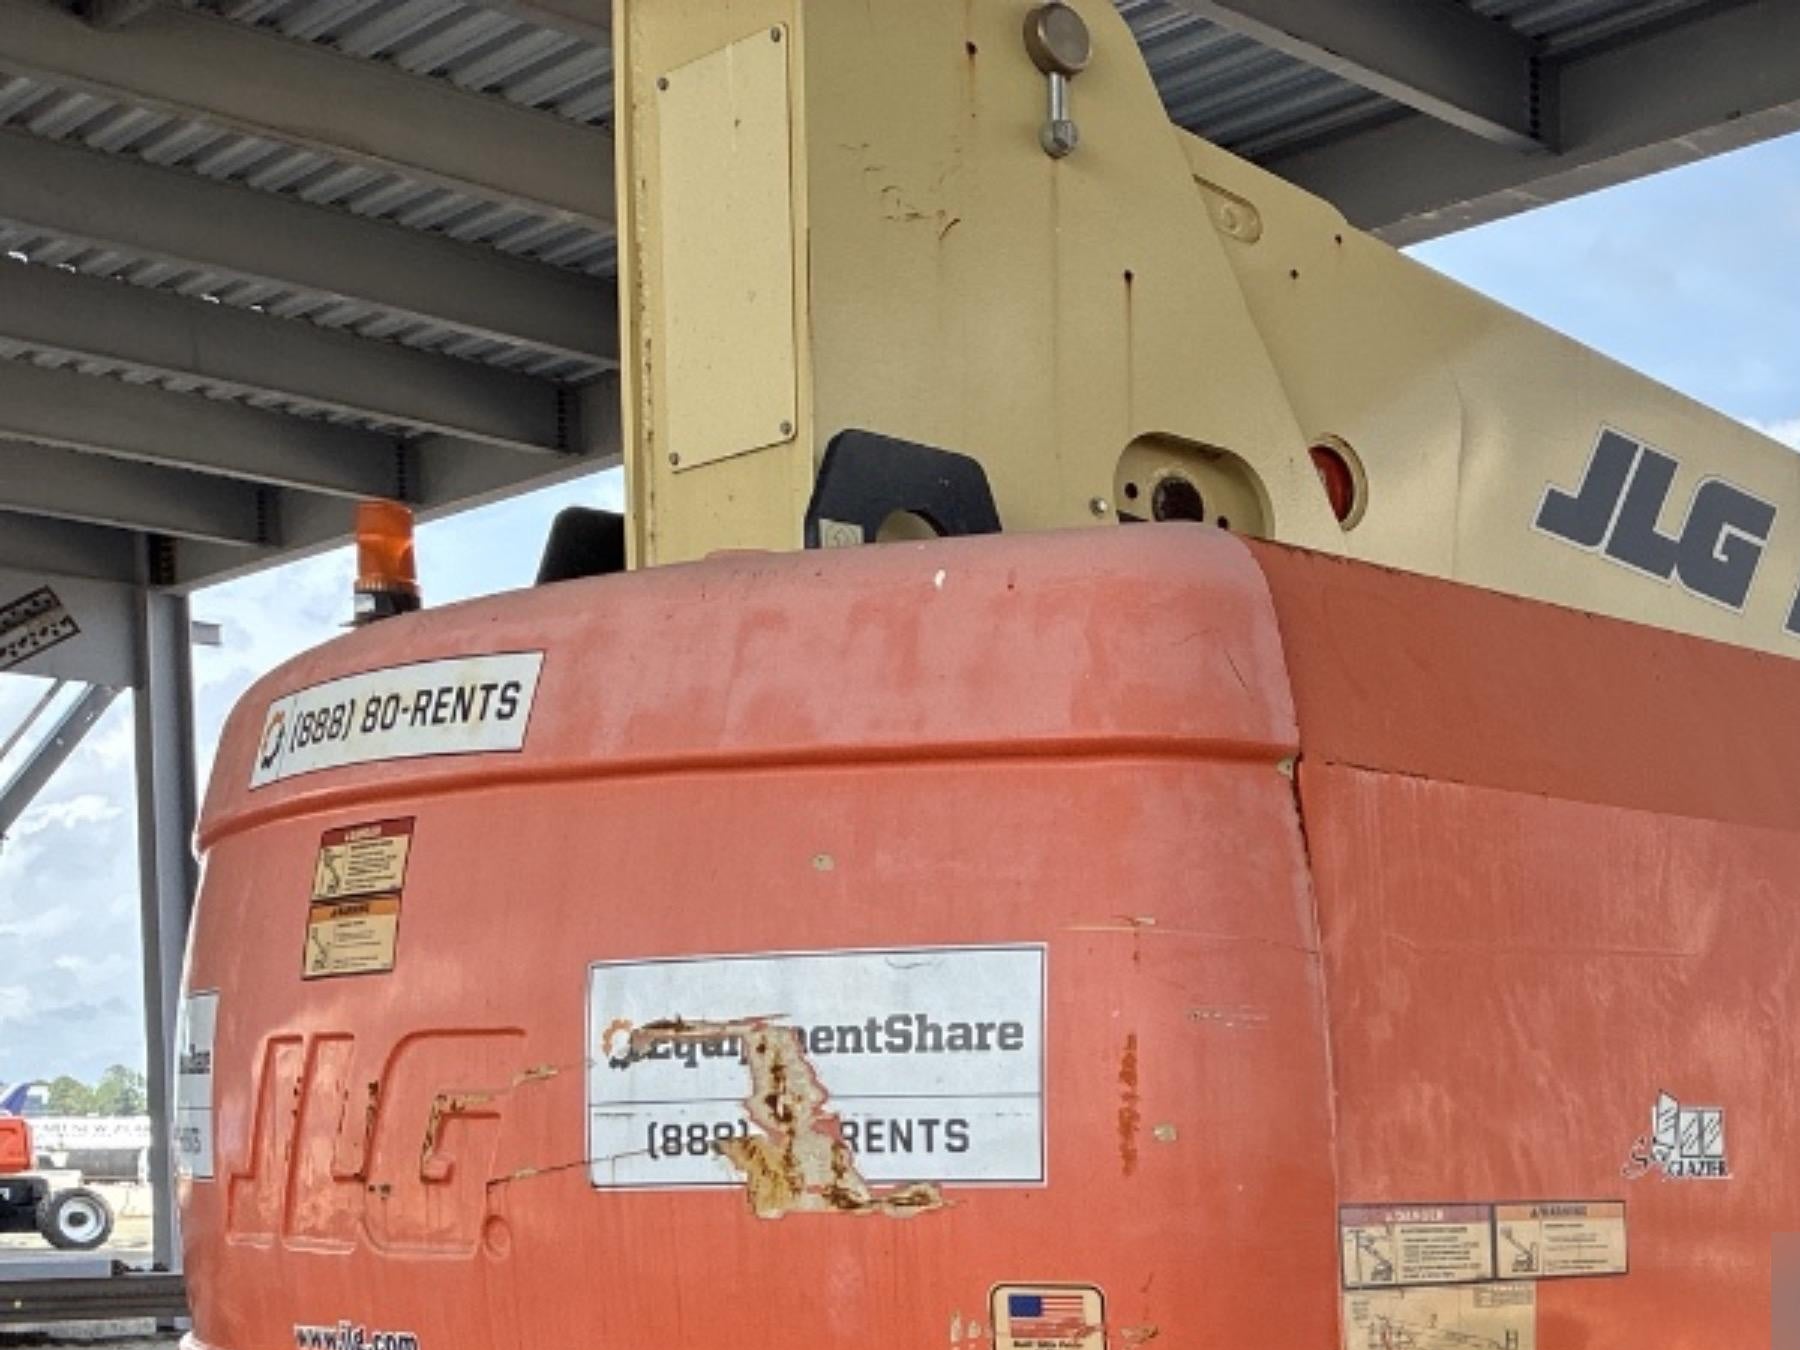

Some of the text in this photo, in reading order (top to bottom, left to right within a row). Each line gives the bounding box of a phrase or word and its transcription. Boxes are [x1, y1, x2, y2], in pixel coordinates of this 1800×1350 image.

[1530, 424, 1777, 614] JLG
[290, 680, 522, 753] (888) 80-RENTS
